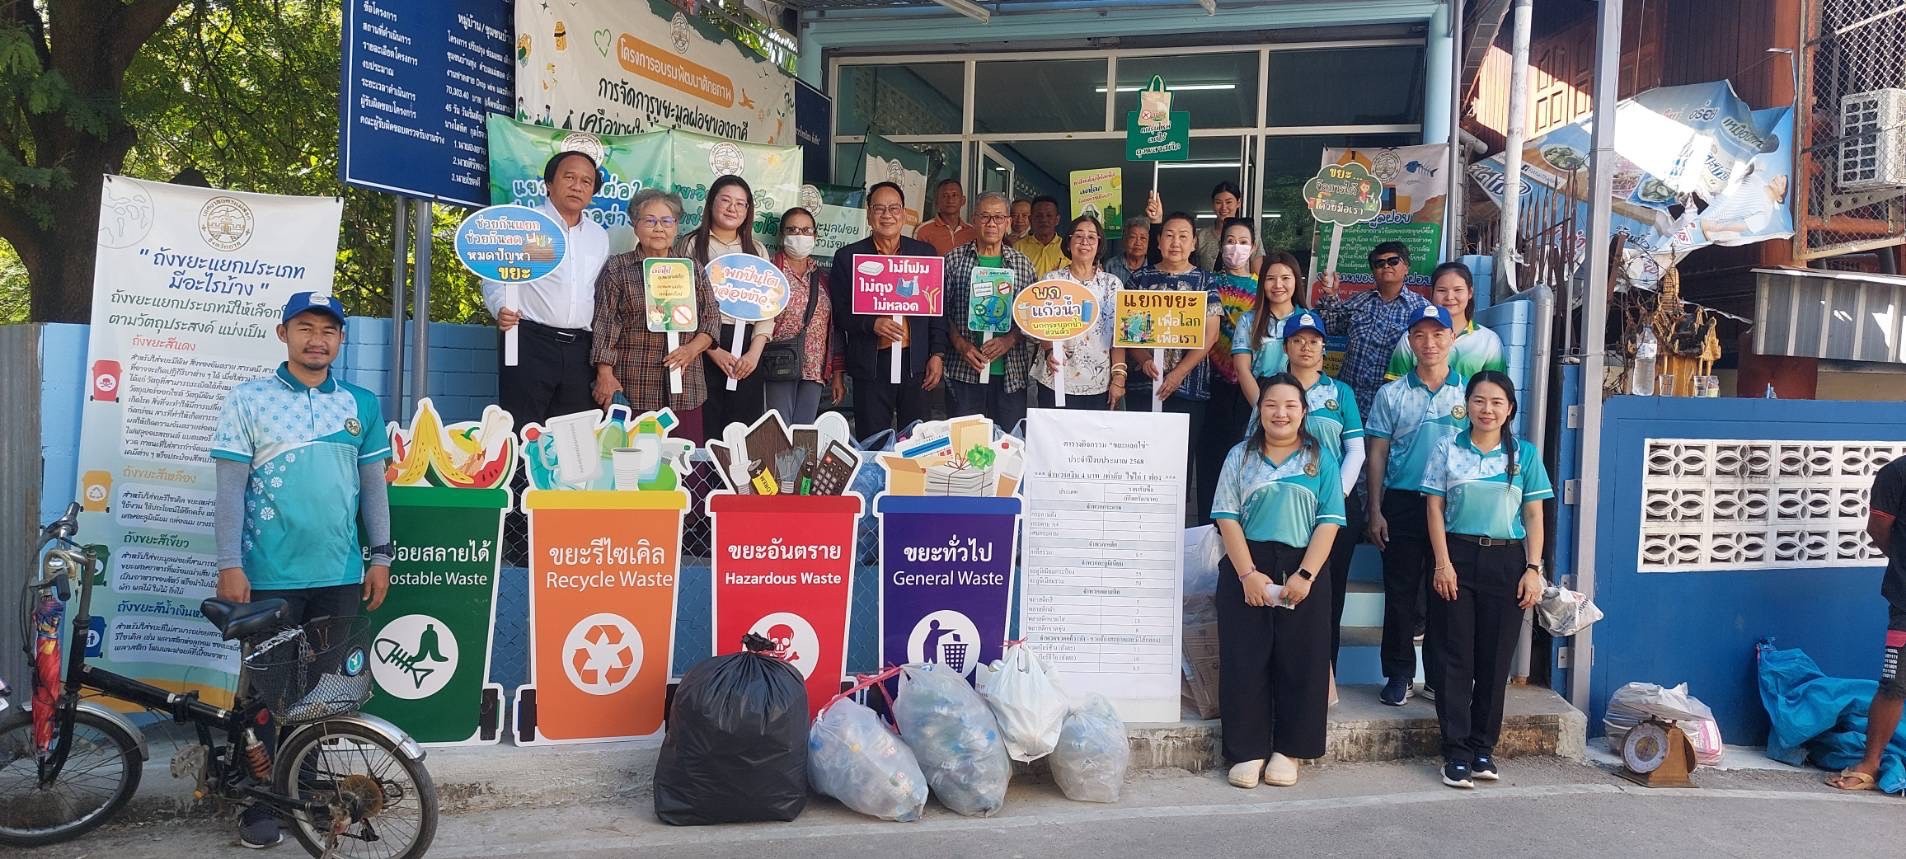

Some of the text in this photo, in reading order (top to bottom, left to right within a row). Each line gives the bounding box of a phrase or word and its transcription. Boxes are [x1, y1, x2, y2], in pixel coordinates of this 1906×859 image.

[362, 60, 394, 76] งบประมาณ
[475, 215, 541, 231] ช่วยกันแยก
[465, 229, 523, 245] ช่วยกันลด
[466, 247, 531, 264] หมดปัญหา
[498, 266, 531, 281] ขยะ
[888, 258, 930, 274] ไม่โฟม
[859, 277, 894, 296] ไม่ถุง
[1032, 285, 1061, 300] พก
[873, 296, 919, 312] ไม่หลอด
[1124, 294, 1197, 308] แยกขยะ
[108, 312, 267, 338] ตามวัตถุประสงค์ แบ่งเป็น
[1157, 309, 1201, 327] เพื่อโลก
[132, 333, 196, 352] ถังขยะสีแดง
[1157, 327, 1197, 344] เพื่อเรา
[124, 531, 189, 548] ถังขยะสีเขียว
[549, 537, 665, 566] ขยะรีไซเคิล
[728, 537, 842, 561] ขยะอันตราย
[903, 534, 993, 562] ขยะทั่วไป
[445, 572, 488, 585] Waste
[547, 571, 673, 592] Recycle Waste
[725, 572, 842, 585] Hazardous Waste
[893, 571, 1004, 586] General Waste
